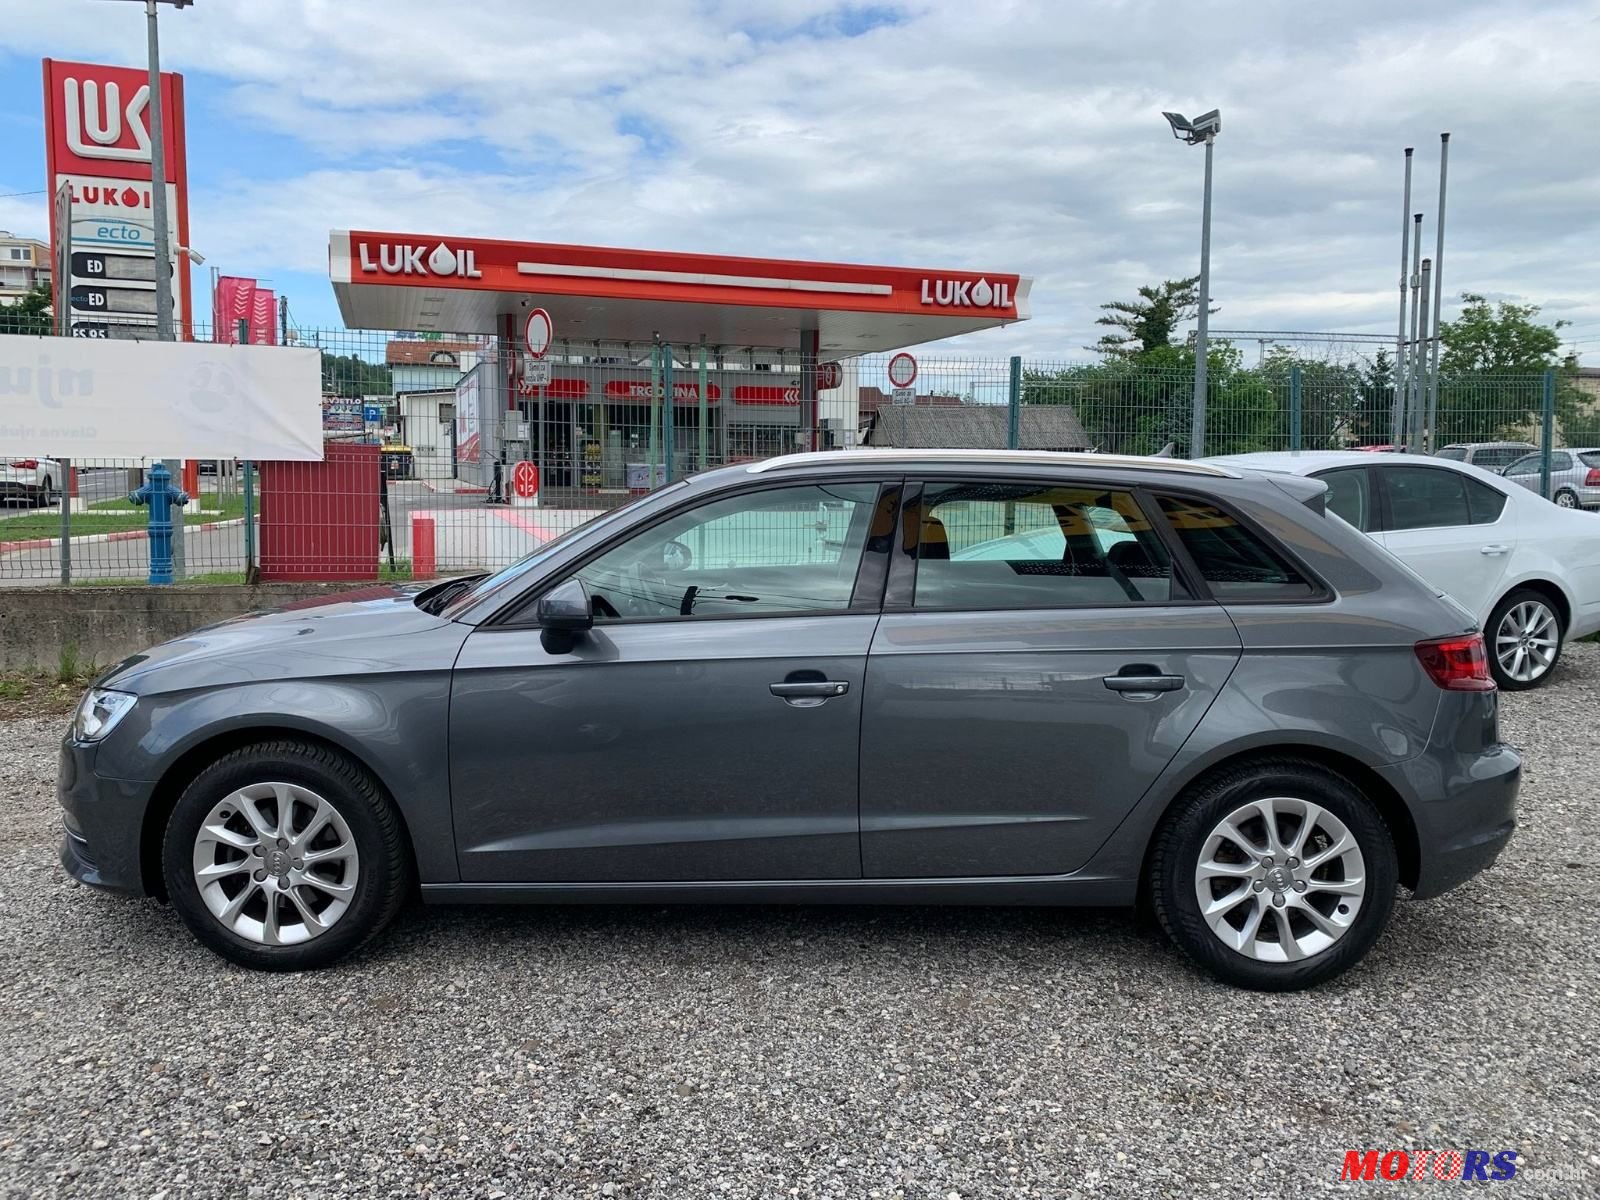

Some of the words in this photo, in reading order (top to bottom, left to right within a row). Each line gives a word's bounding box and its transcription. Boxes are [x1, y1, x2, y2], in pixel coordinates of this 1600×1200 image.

[69, 185, 150, 208] LUKOI
[97, 226, 141, 240] ecto
[87, 260, 103, 273] ED
[359, 242, 483, 278] LUKOIL
[88, 293, 104, 306] ED
[921, 277, 1013, 309] LUKOIL
[629, 385, 698, 398] TRGOINA
